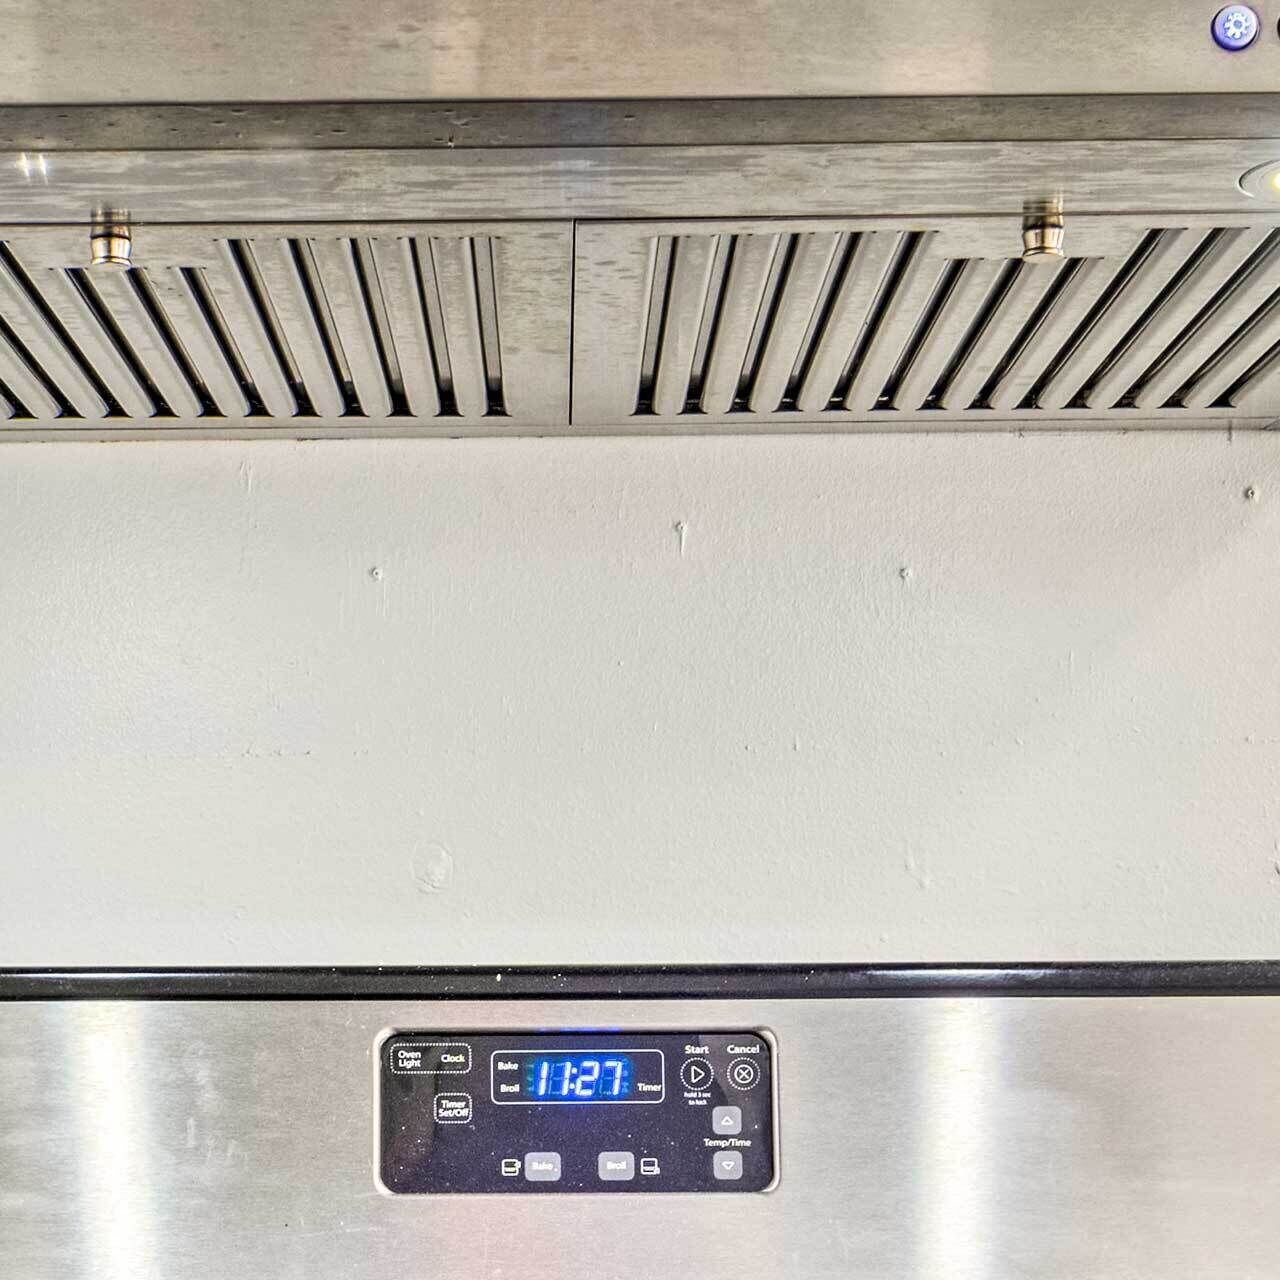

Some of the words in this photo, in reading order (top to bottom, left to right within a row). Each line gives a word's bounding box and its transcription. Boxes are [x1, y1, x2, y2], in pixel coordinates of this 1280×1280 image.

[685, 1045, 709, 1054] Start
[727, 1044, 760, 1054] Cancel
[398, 1050, 421, 1059] Oven
[441, 1054, 465, 1063] Clock
[399, 1059, 421, 1068] Light
[498, 1061, 519, 1070] Bake
[538, 1060, 623, 1096] 11:27
[500, 1084, 520, 1093] Broil
[637, 1083, 662, 1092] Timer
[441, 1100, 466, 1108] Timer
[438, 1108, 469, 1117] Set/Off
[704, 1138, 752, 1147] Temp/Time
